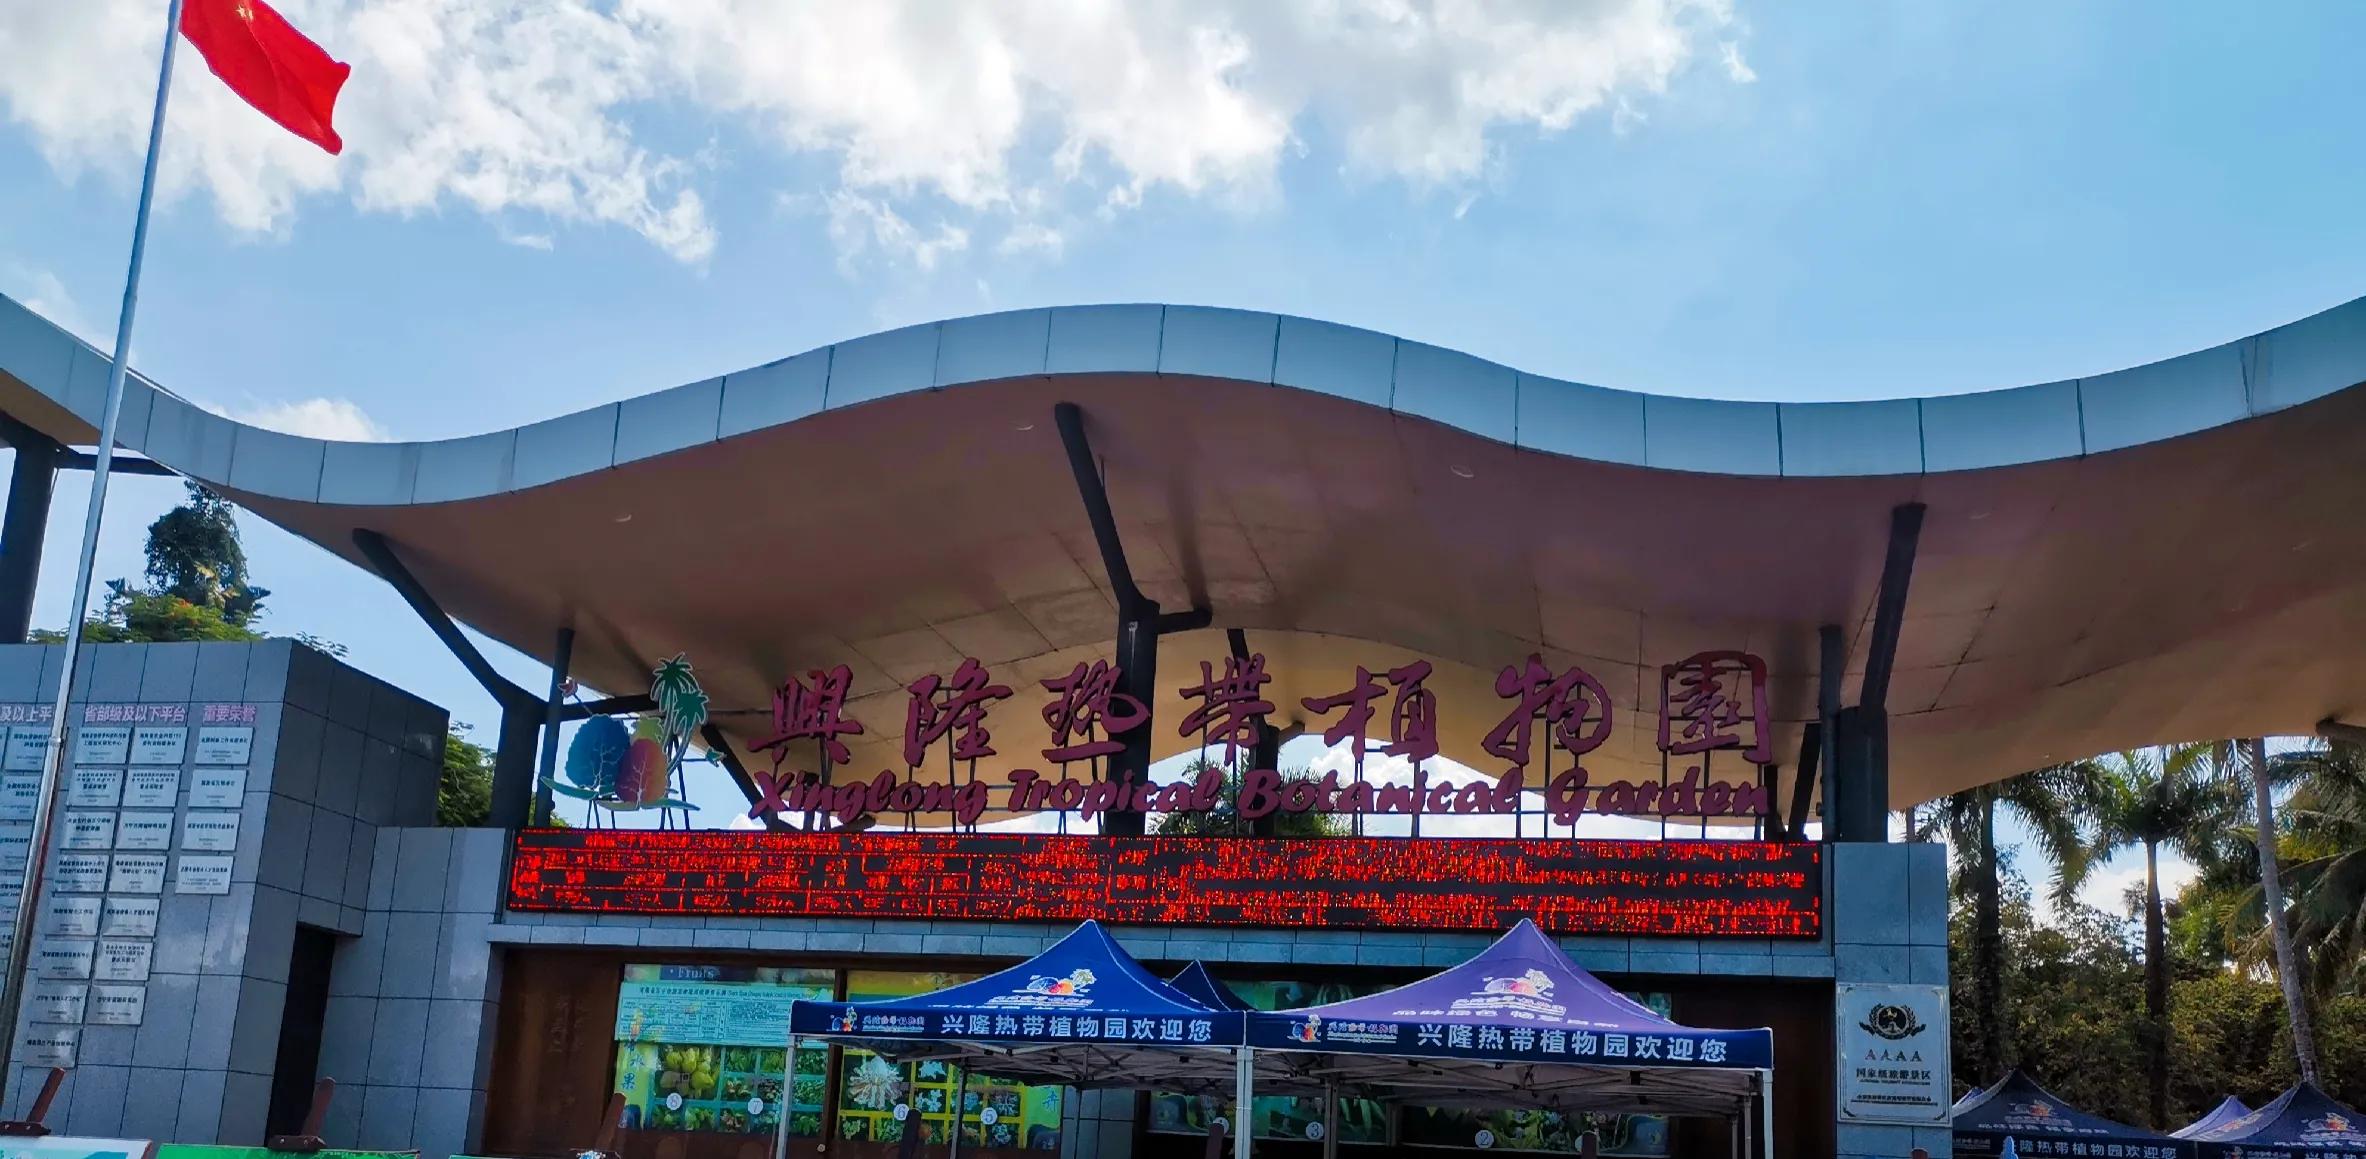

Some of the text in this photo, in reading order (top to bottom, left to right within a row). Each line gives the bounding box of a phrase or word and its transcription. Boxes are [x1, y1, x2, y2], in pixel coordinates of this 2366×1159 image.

[85, 706, 186, 722] 省部级及以下平台
[748, 766, 1769, 825] Xinglong Tropical Botanical Garden
[941, 1013, 1212, 1041] 兴隆热带植物园欢迎您
[1417, 1023, 1727, 1063] 兴隆热带植物园欢迎您
[1856, 1067, 1931, 1080] 国家级旅游景区
